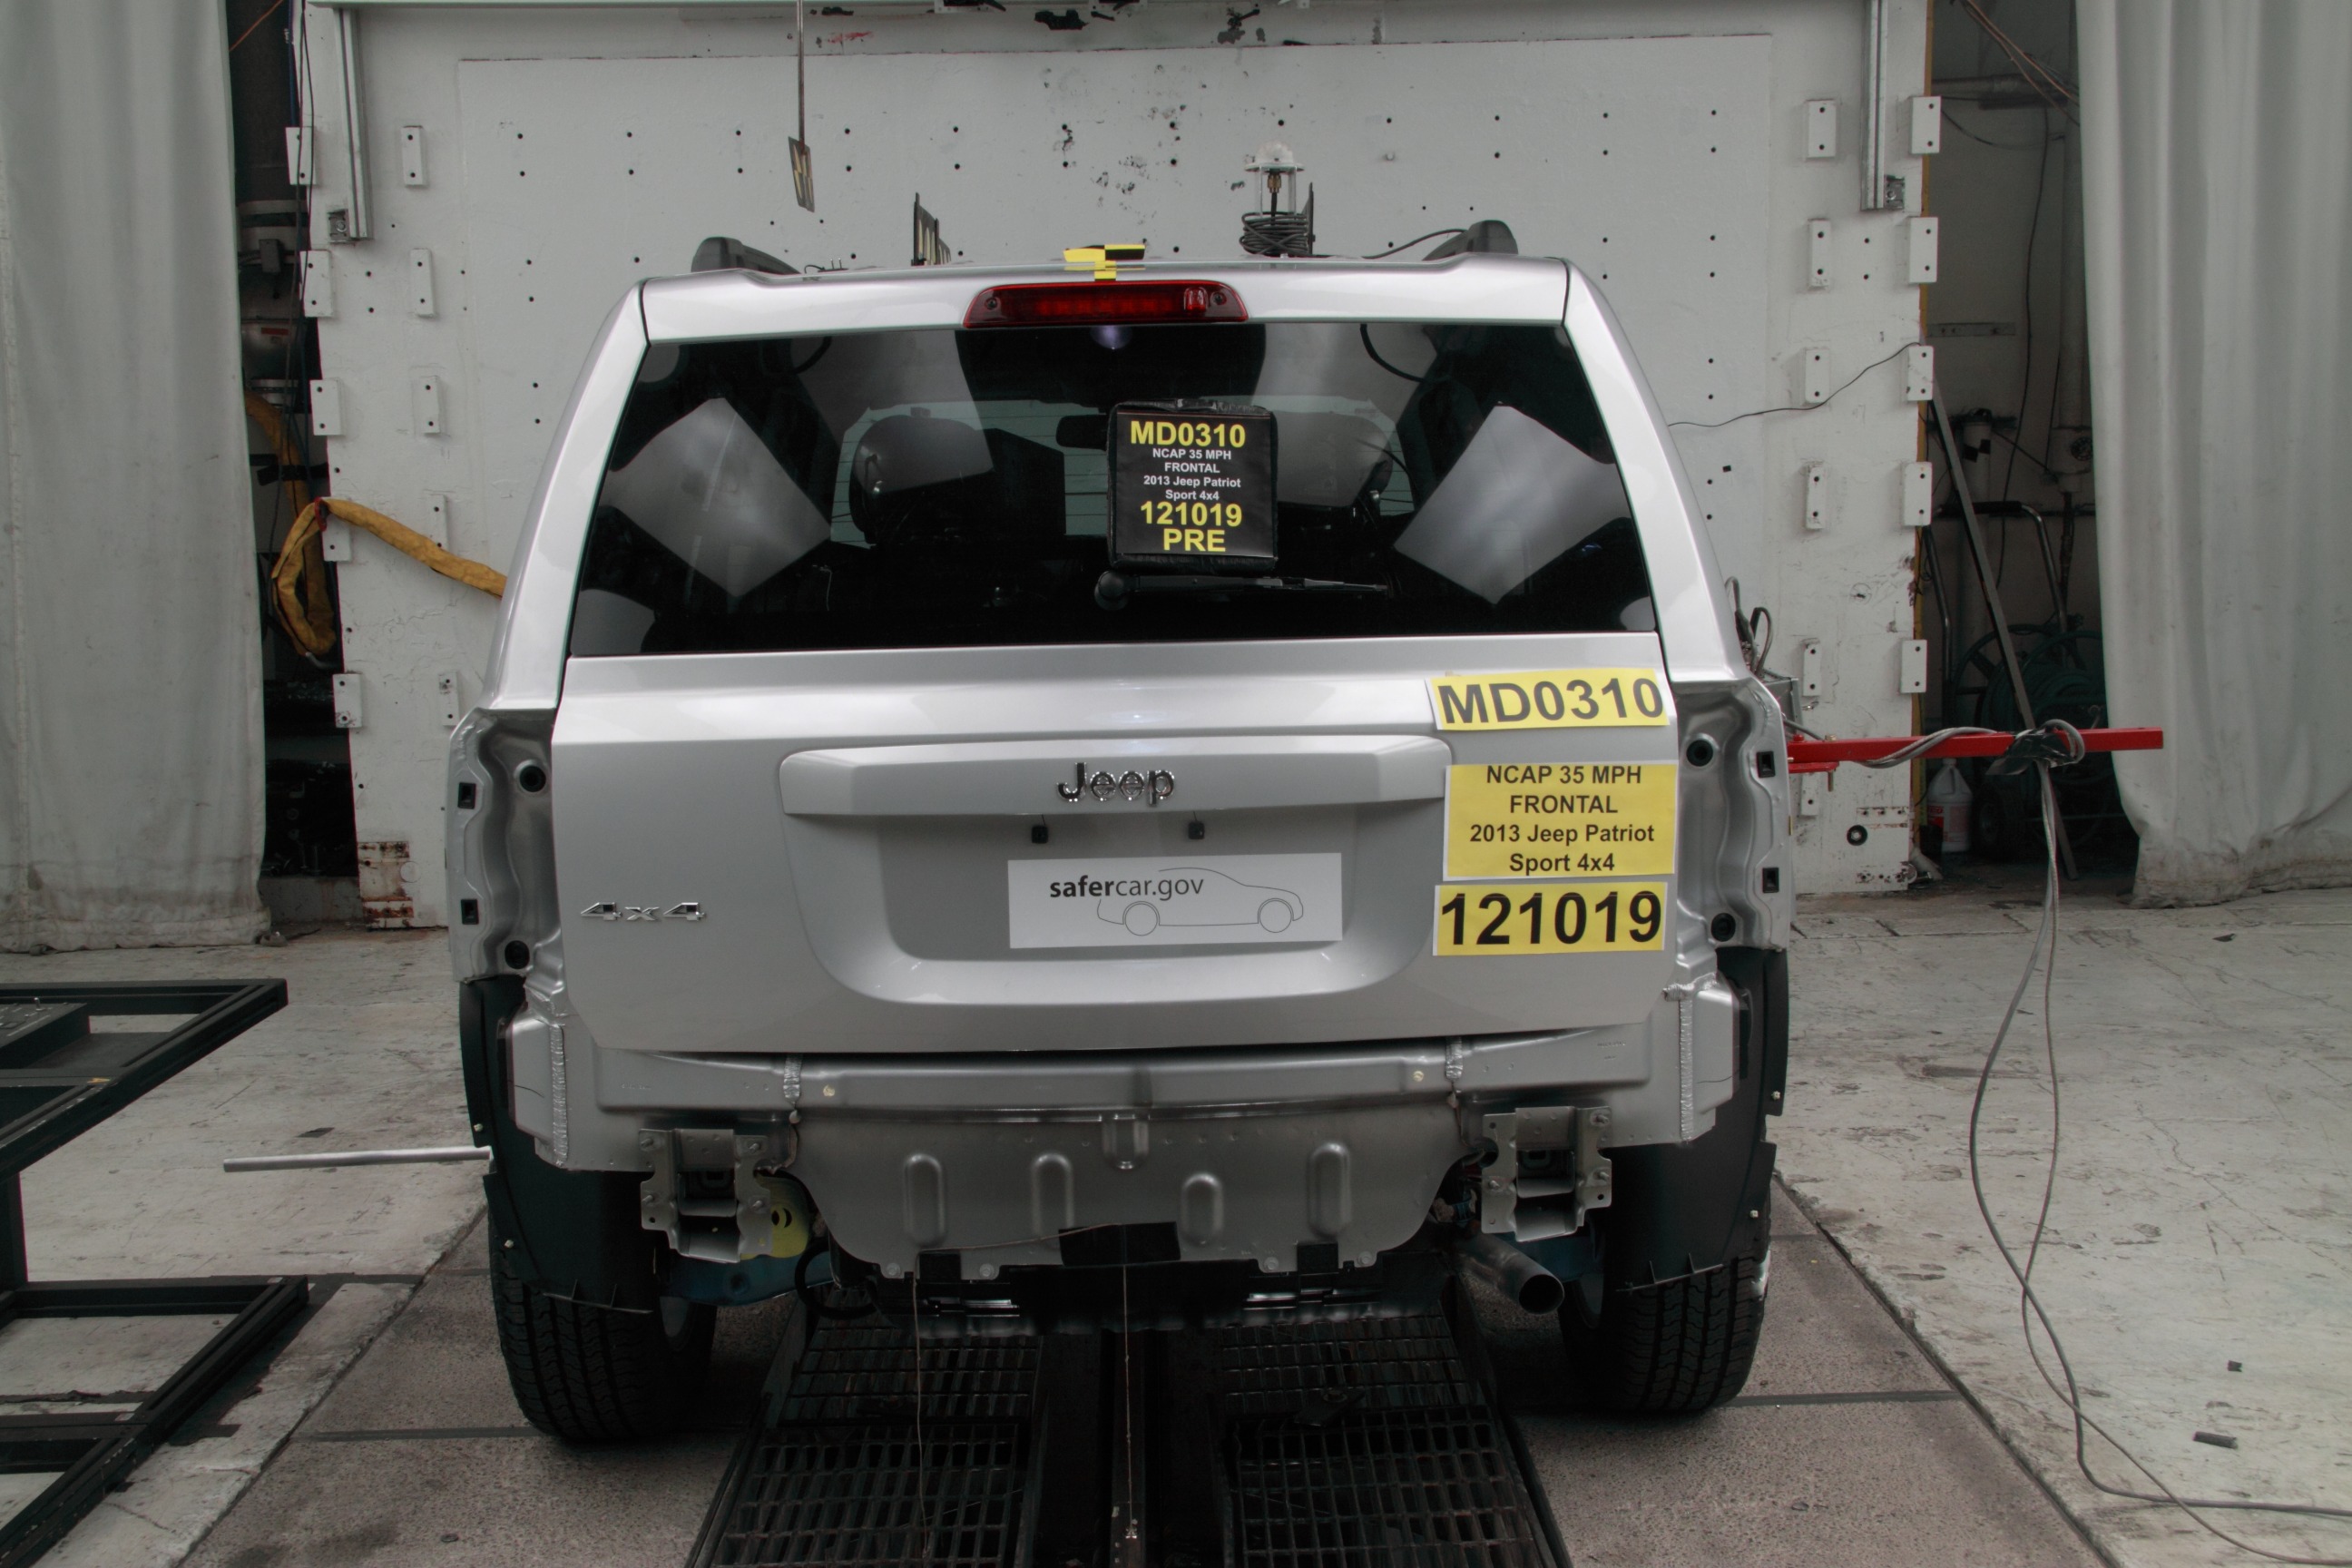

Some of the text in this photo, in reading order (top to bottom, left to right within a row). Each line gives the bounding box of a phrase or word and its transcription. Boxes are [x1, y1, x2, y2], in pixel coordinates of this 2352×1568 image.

[1131, 420, 1246, 447] MD0310
[1152, 447, 1231, 460] NCAP 35 MPH
[1164, 462, 1220, 473] FRONTAL
[1143, 475, 1241, 488] 2013 Jeep Patriot
[1165, 489, 1220, 501] Sport 4x4
[1141, 501, 1242, 527] 121019
[1163, 528, 1226, 552] PRE
[1437, 678, 1663, 724] MD0310
[1056, 762, 1174, 807] Jeep
[1486, 765, 1642, 784] NCAP 35 MPH
[1510, 794, 1618, 814] FRONTAL
[1470, 824, 1654, 846] 2013 Jeep Patriot
[1509, 852, 1615, 876] Sport 4x4
[1049, 875, 1204, 901] safercar.gov
[581, 901, 705, 921] 4x4
[1441, 890, 1661, 946] 121019
